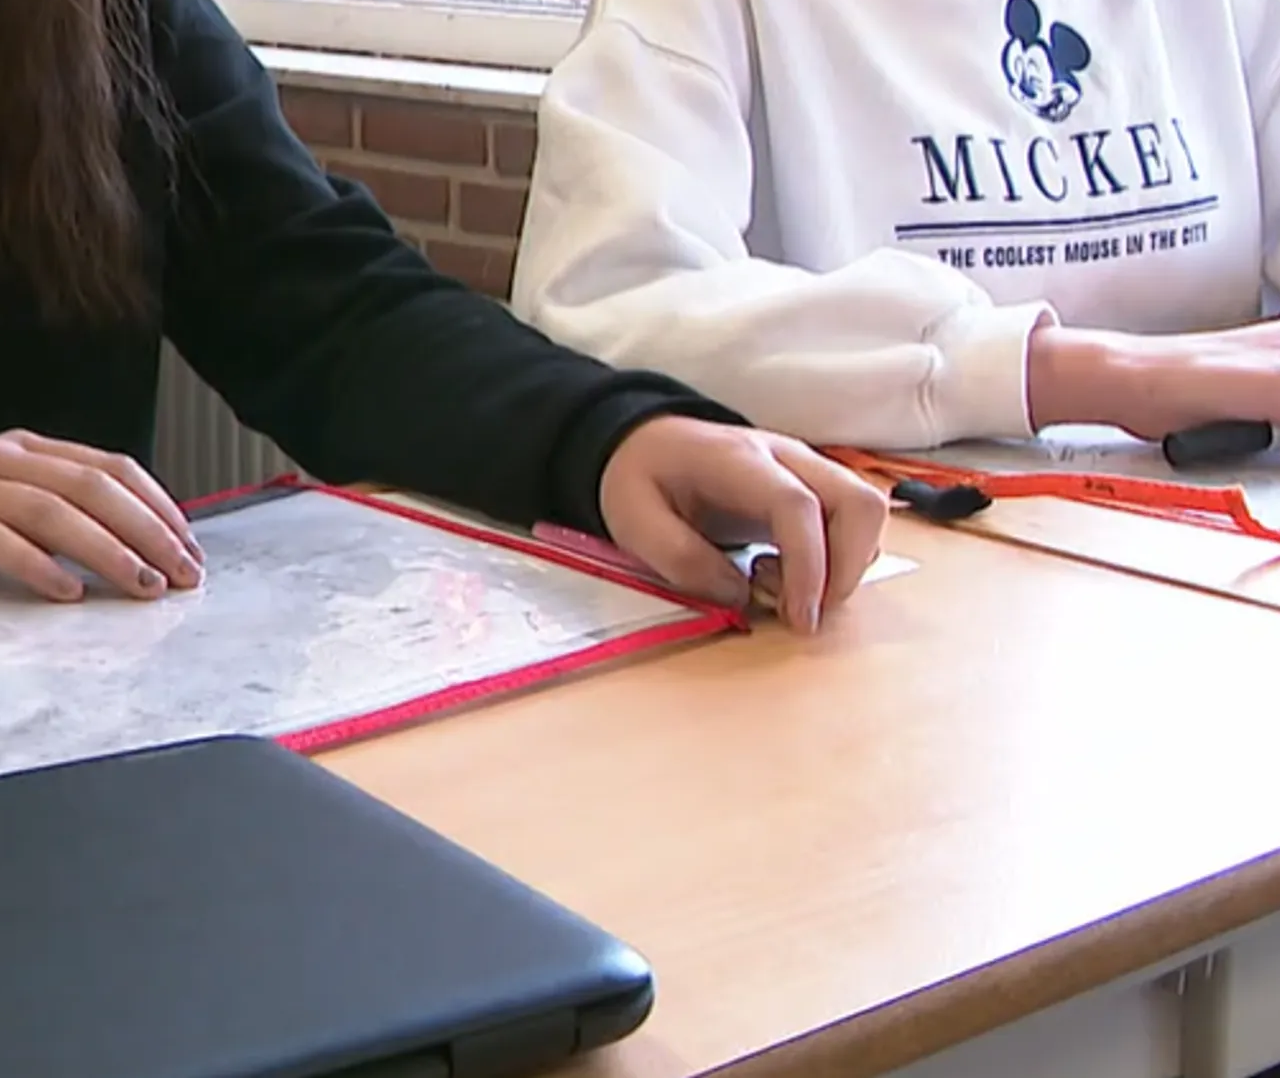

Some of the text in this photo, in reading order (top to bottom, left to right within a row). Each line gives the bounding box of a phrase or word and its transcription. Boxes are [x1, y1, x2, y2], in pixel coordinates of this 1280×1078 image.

[982, 244, 1056, 268] COOLEST
[1064, 238, 1120, 264] MOUSE
[1125, 233, 1144, 255] IN
[1149, 228, 1177, 251] THE
[1181, 221, 1208, 246] CITY
